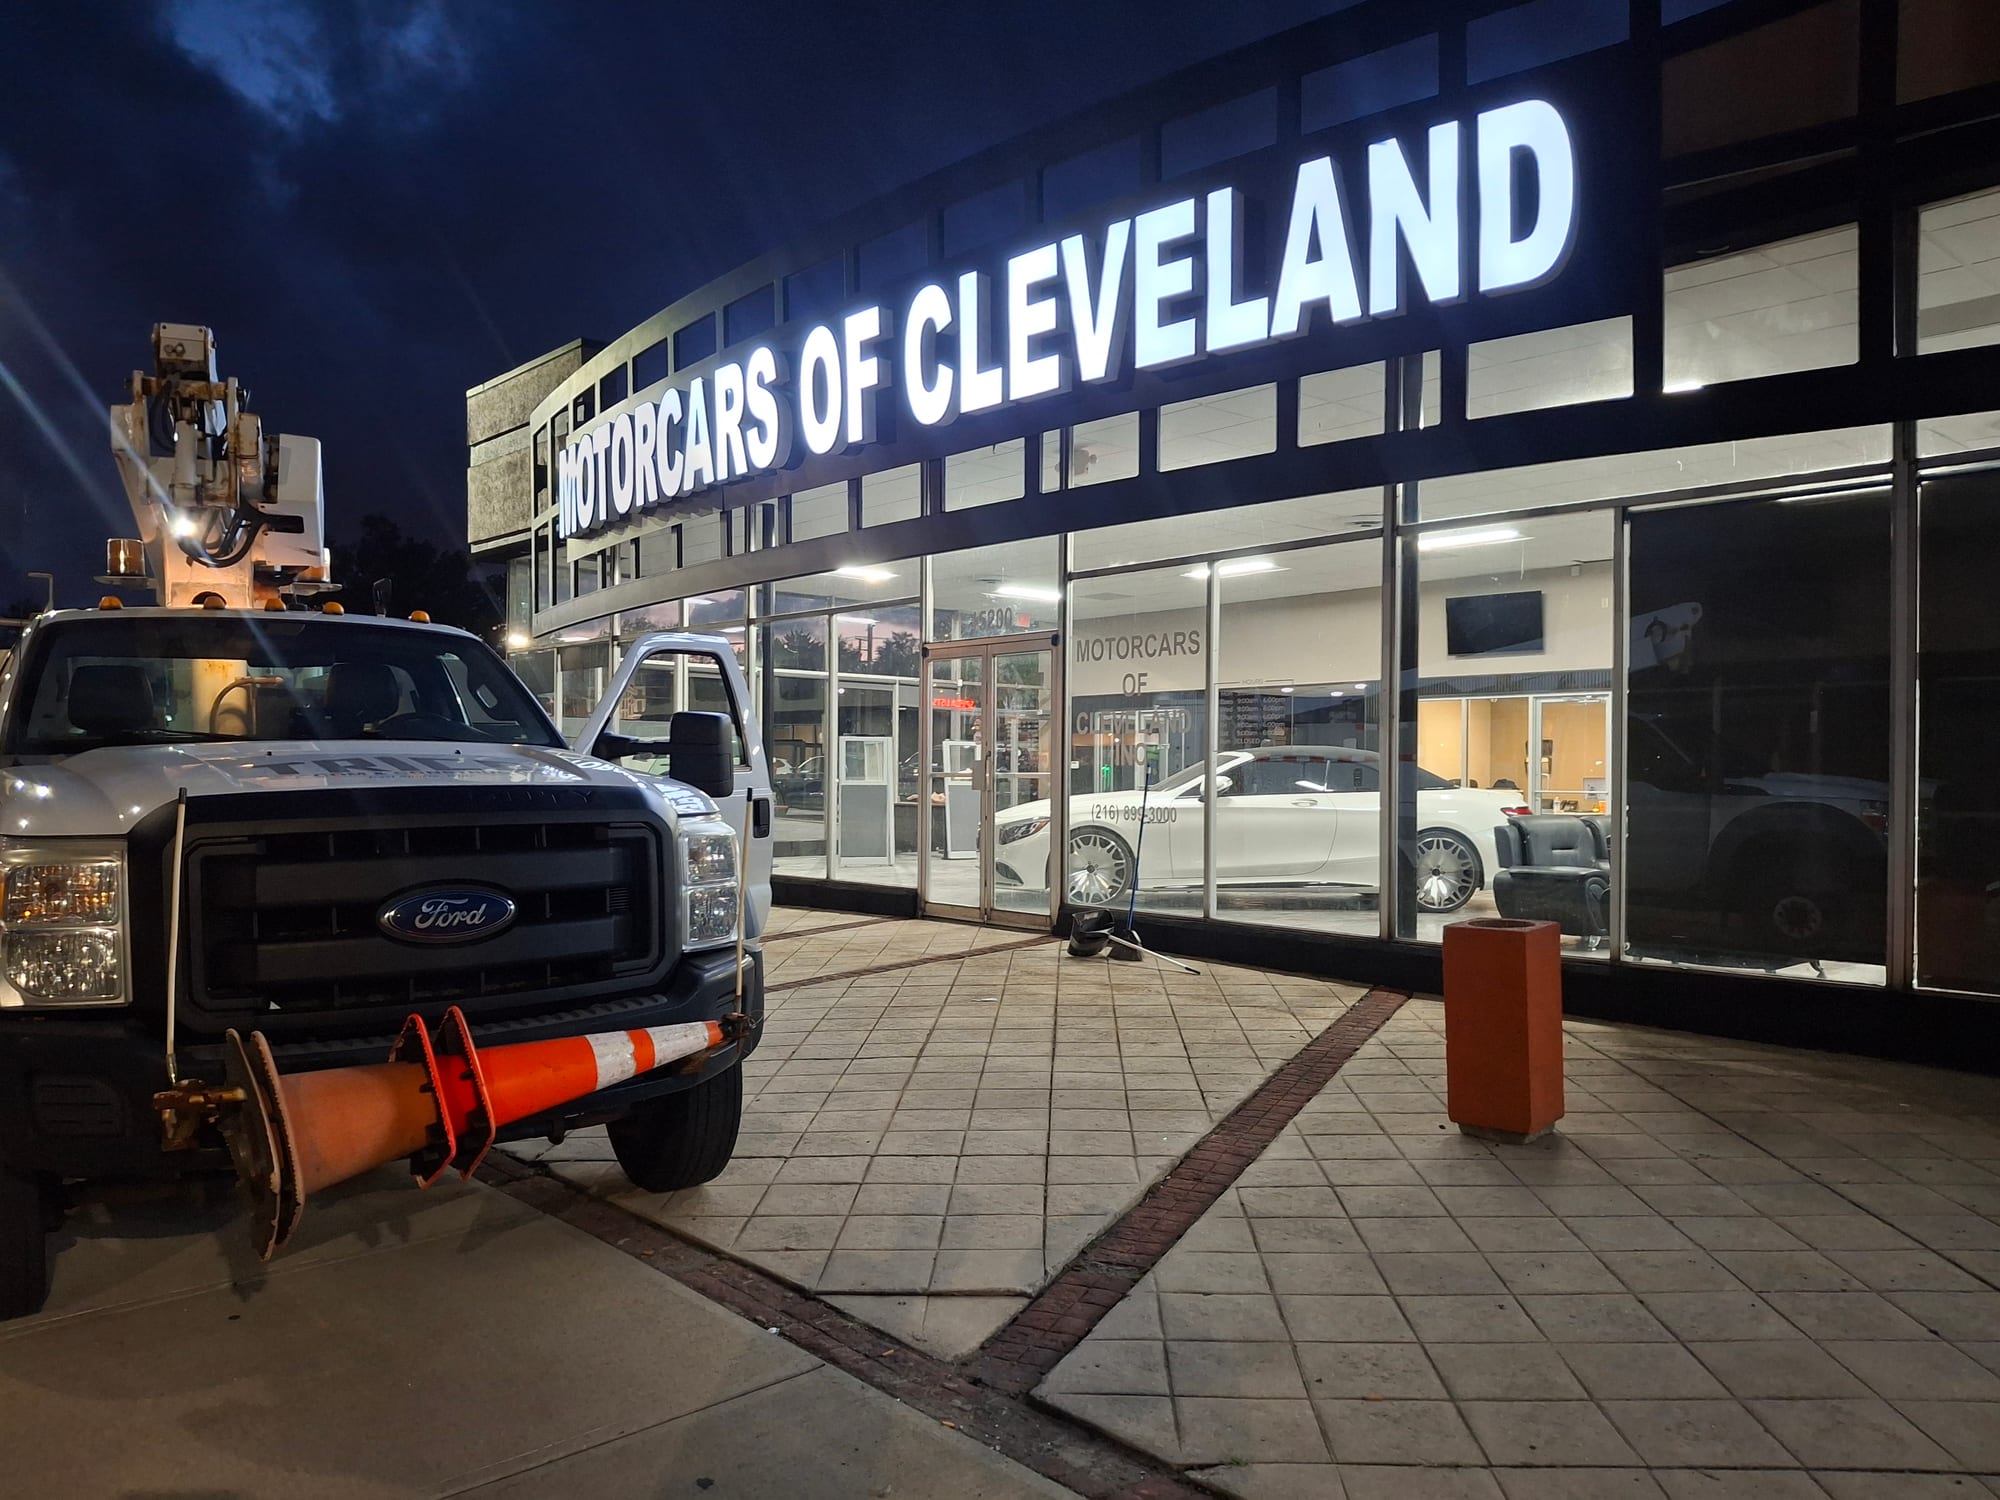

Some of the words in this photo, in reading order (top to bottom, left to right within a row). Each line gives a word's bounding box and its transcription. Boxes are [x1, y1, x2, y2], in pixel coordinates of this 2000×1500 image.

[558, 346, 780, 540] MOTORCARS
[799, 305, 882, 455] OF
[904, 99, 1575, 427] CLEVELAND
[1076, 630, 1200, 662] MOTORCARS
[1122, 672, 1148, 697] OF
[1076, 709, 1192, 735] CLEVELAND
[1091, 803, 1119, 824] (216)
[414, 898, 488, 929] Ford
